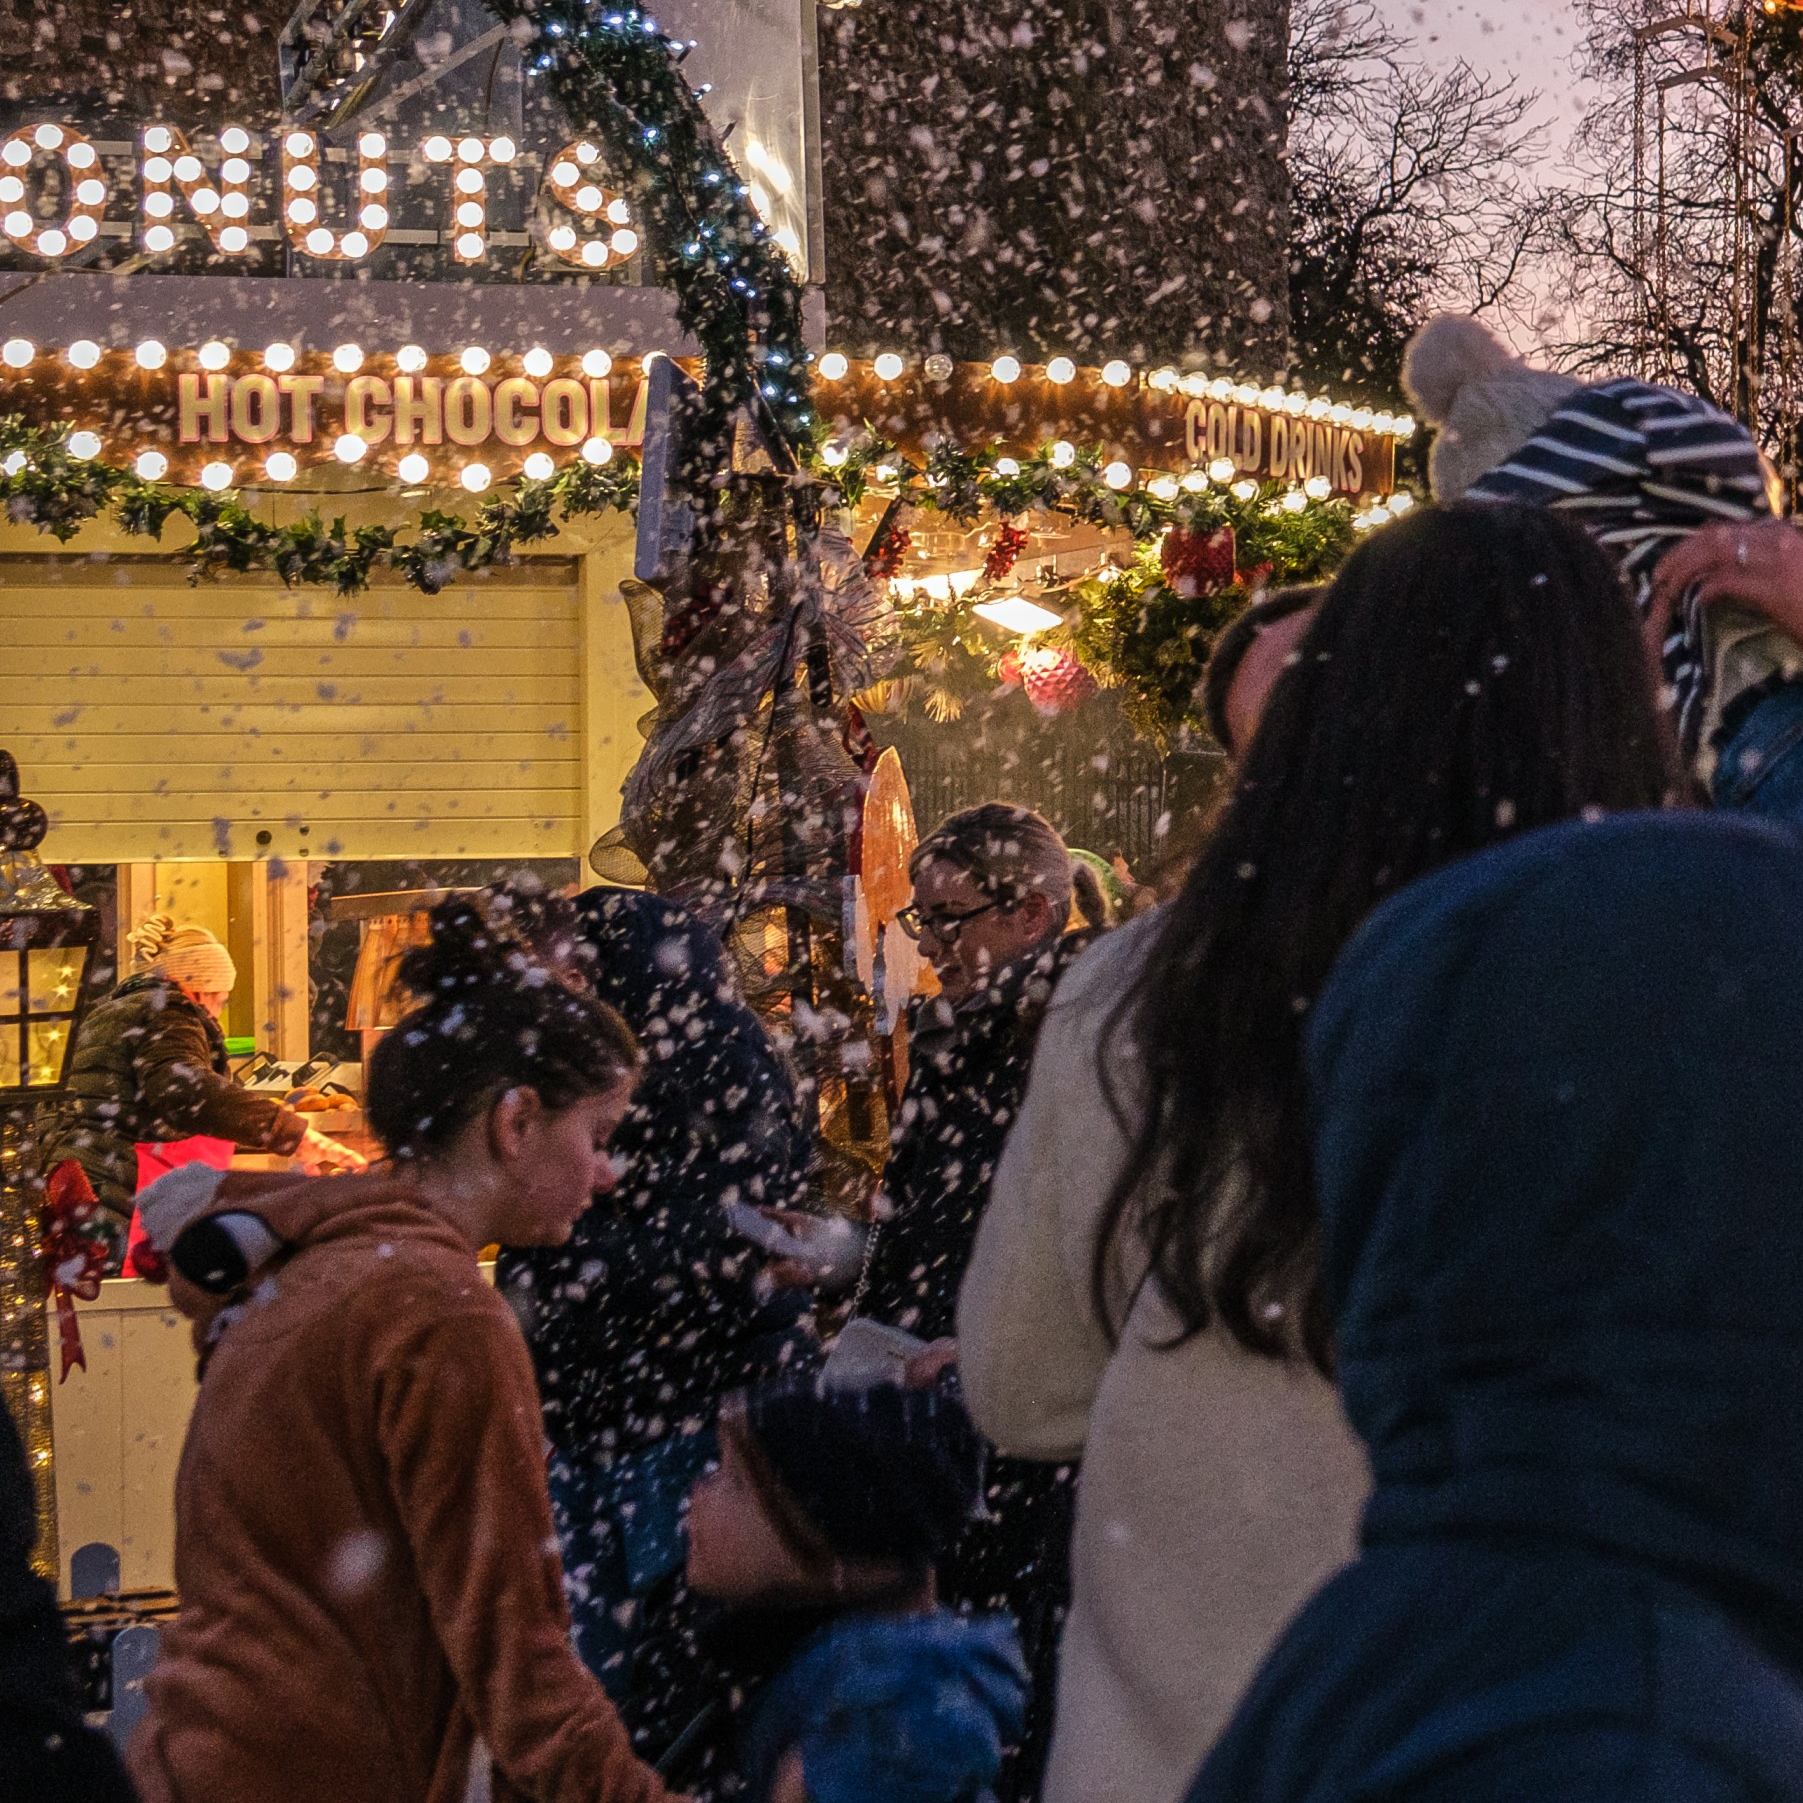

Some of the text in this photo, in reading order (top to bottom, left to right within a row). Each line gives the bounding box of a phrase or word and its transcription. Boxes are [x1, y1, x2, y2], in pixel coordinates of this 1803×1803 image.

[179, 373, 325, 443] HOT
[1185, 398, 1364, 493] COLD DRINKS
